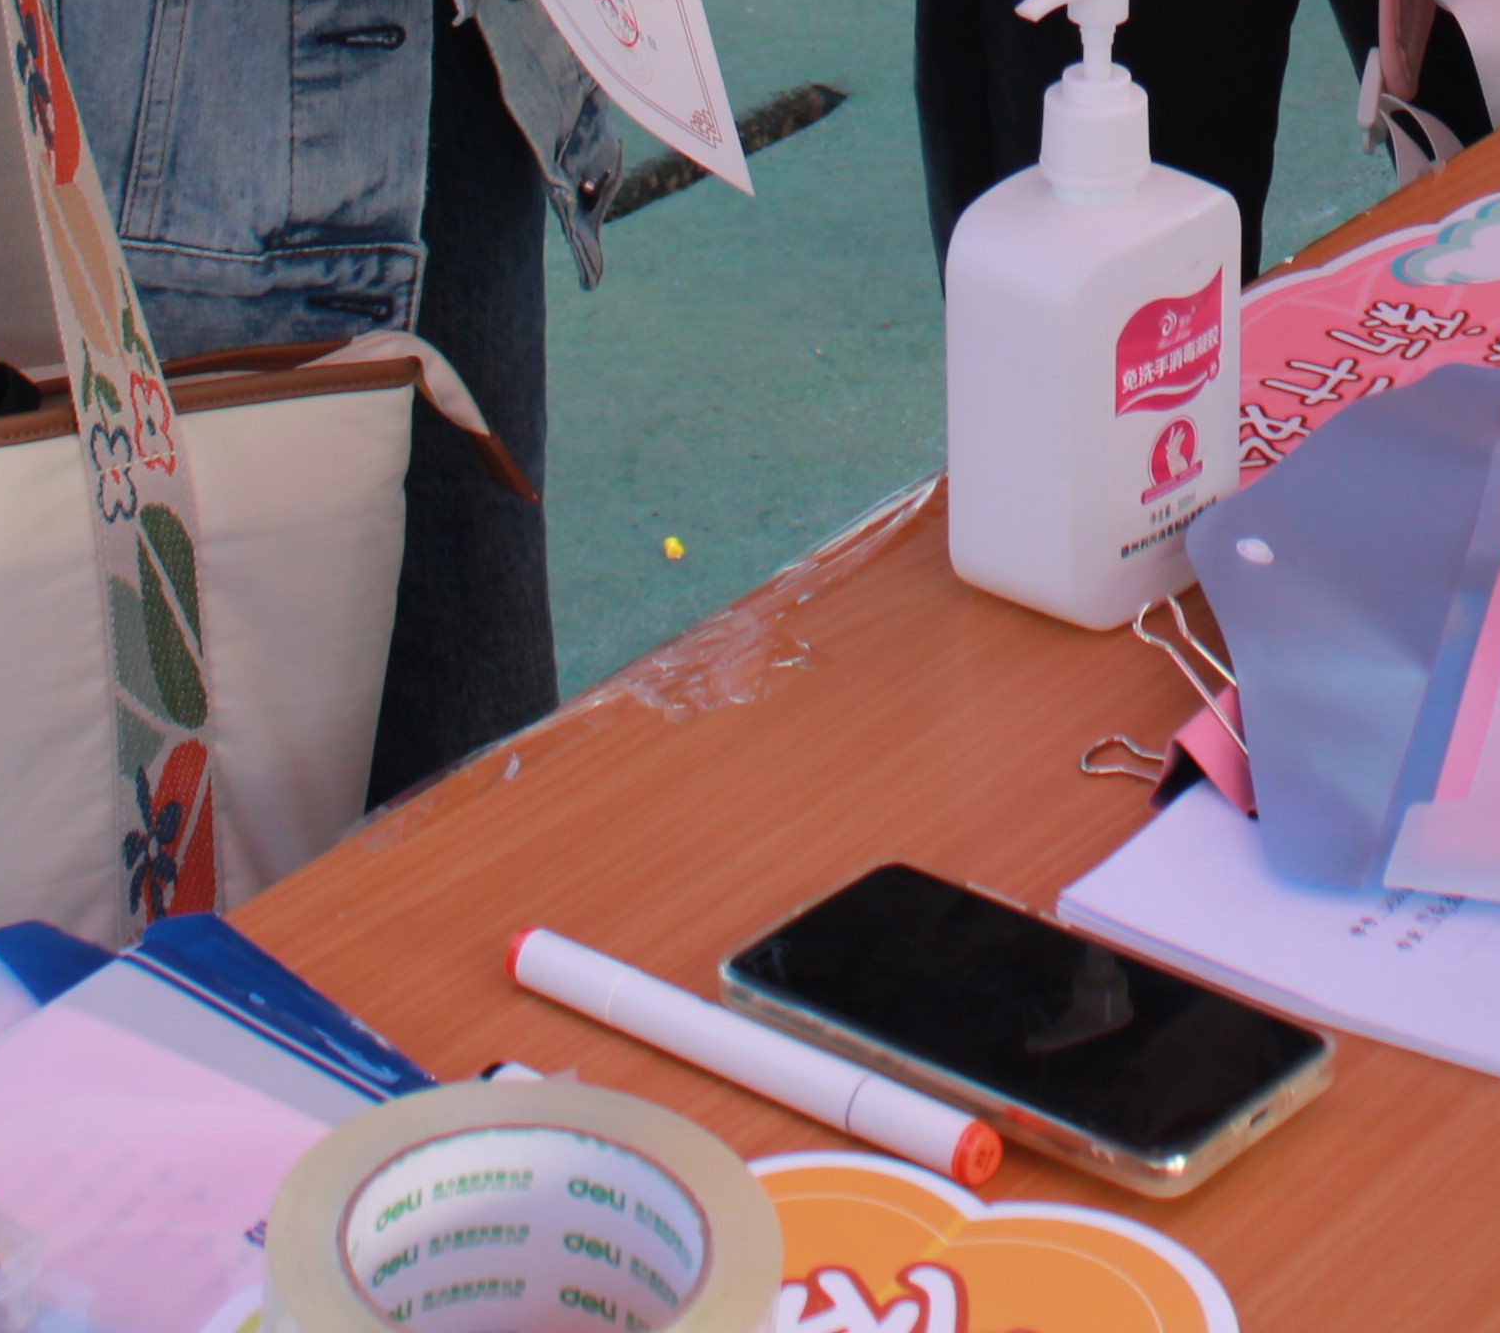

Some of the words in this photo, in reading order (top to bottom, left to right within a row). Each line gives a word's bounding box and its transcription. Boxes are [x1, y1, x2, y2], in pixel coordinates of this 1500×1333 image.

[376, 1188, 422, 1232] deli
[568, 1176, 626, 1213] deli
[372, 1243, 419, 1288] deli
[563, 1231, 622, 1268] deli
[559, 1285, 617, 1322] deli
